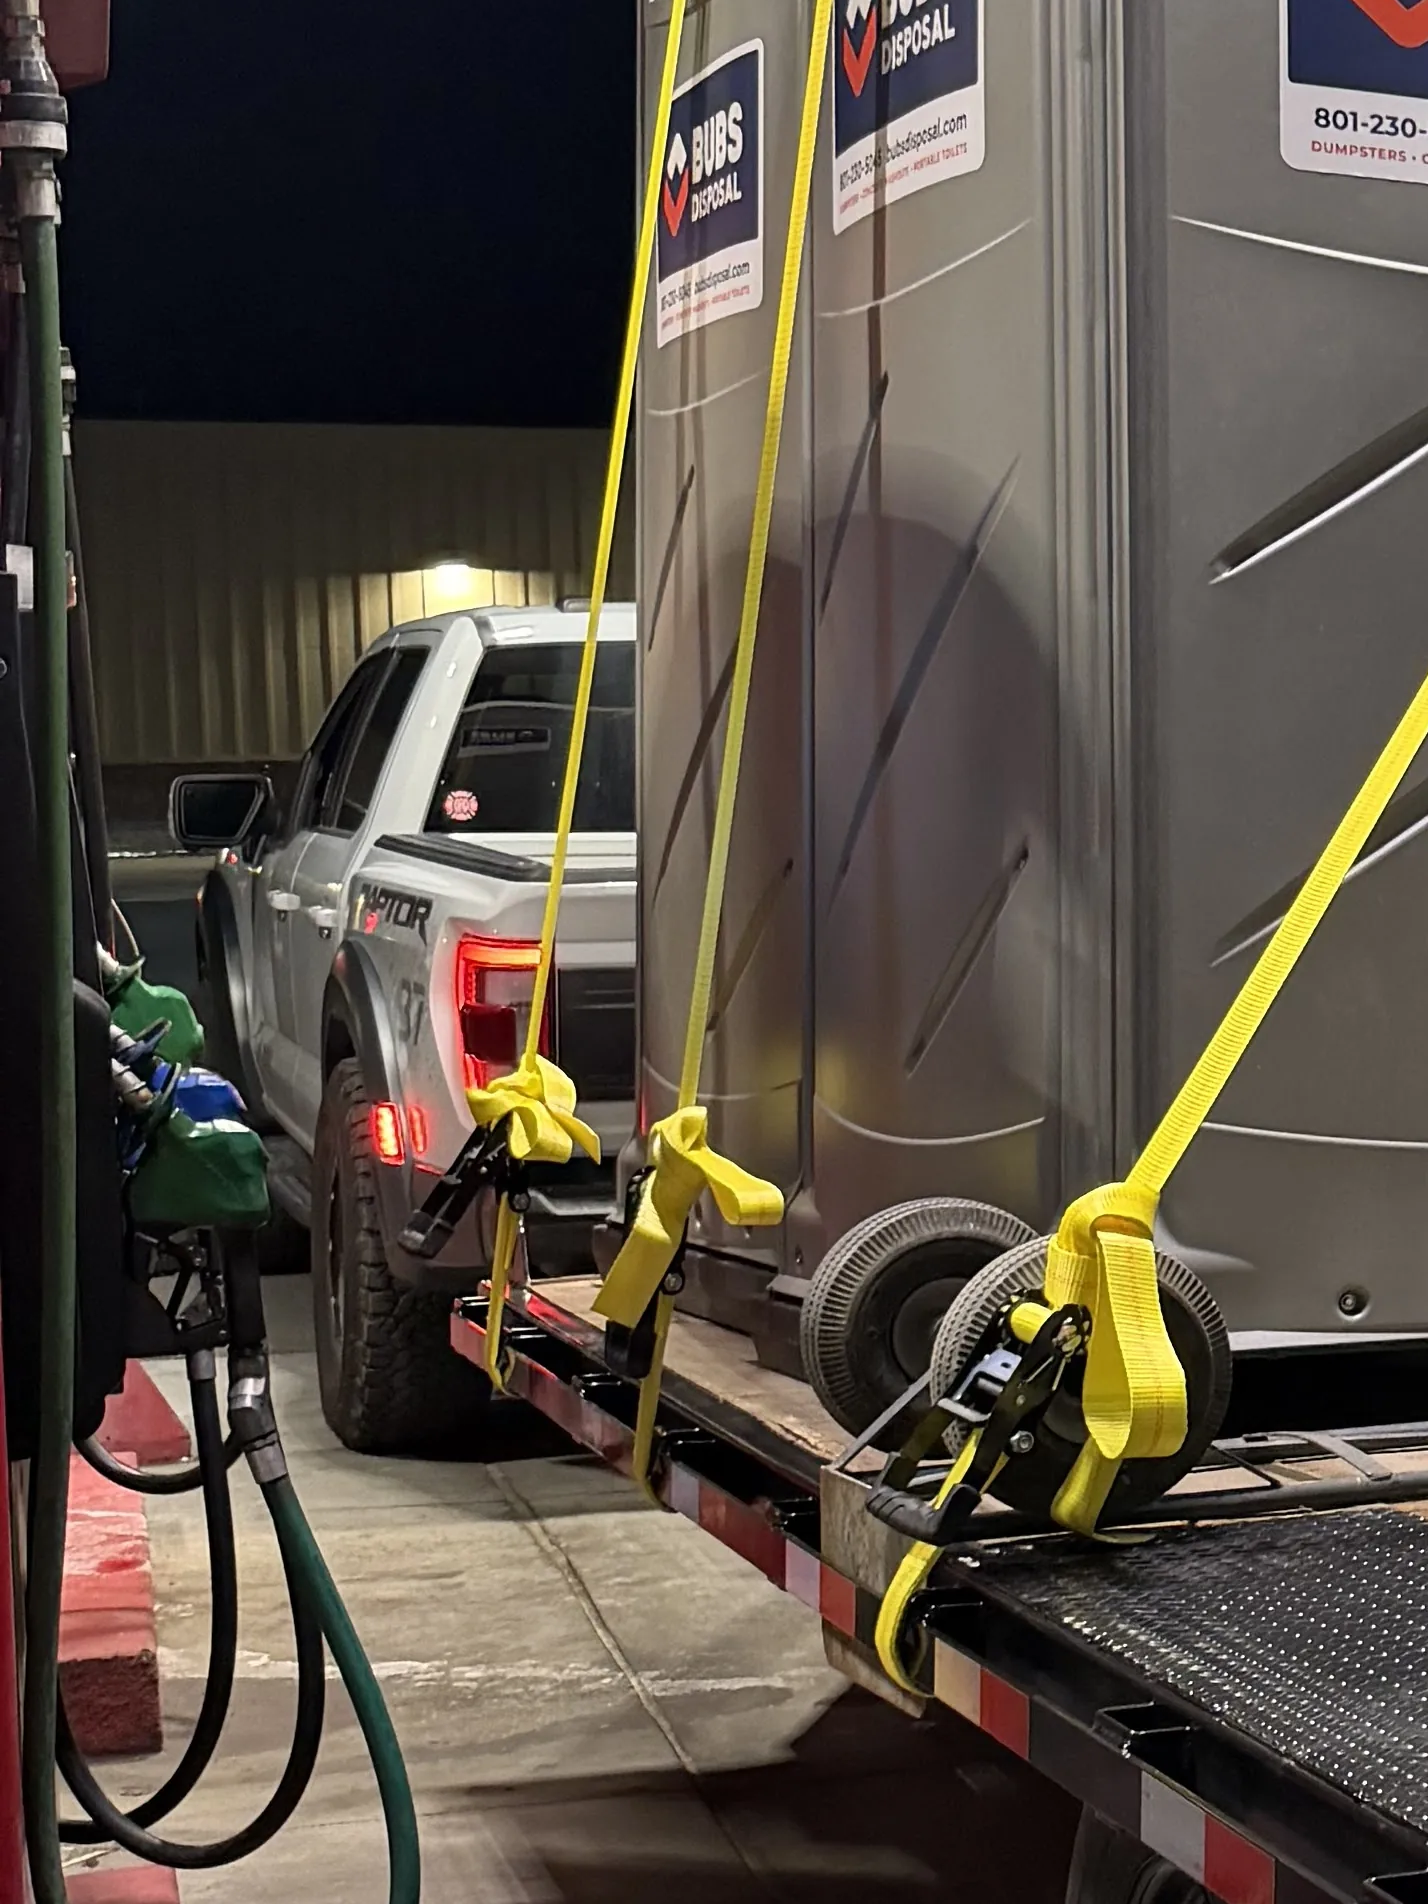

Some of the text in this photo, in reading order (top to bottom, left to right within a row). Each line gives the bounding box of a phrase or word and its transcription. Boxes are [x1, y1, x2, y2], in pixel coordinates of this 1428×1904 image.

[881, 3, 955, 75] DISPOSAL
[692, 101, 743, 185] BUBS
[884, 112, 967, 163] bubsdisposal.com
[1311, 140, 1407, 163] DUMPSTERS
[692, 172, 742, 223] DISPOSAL
